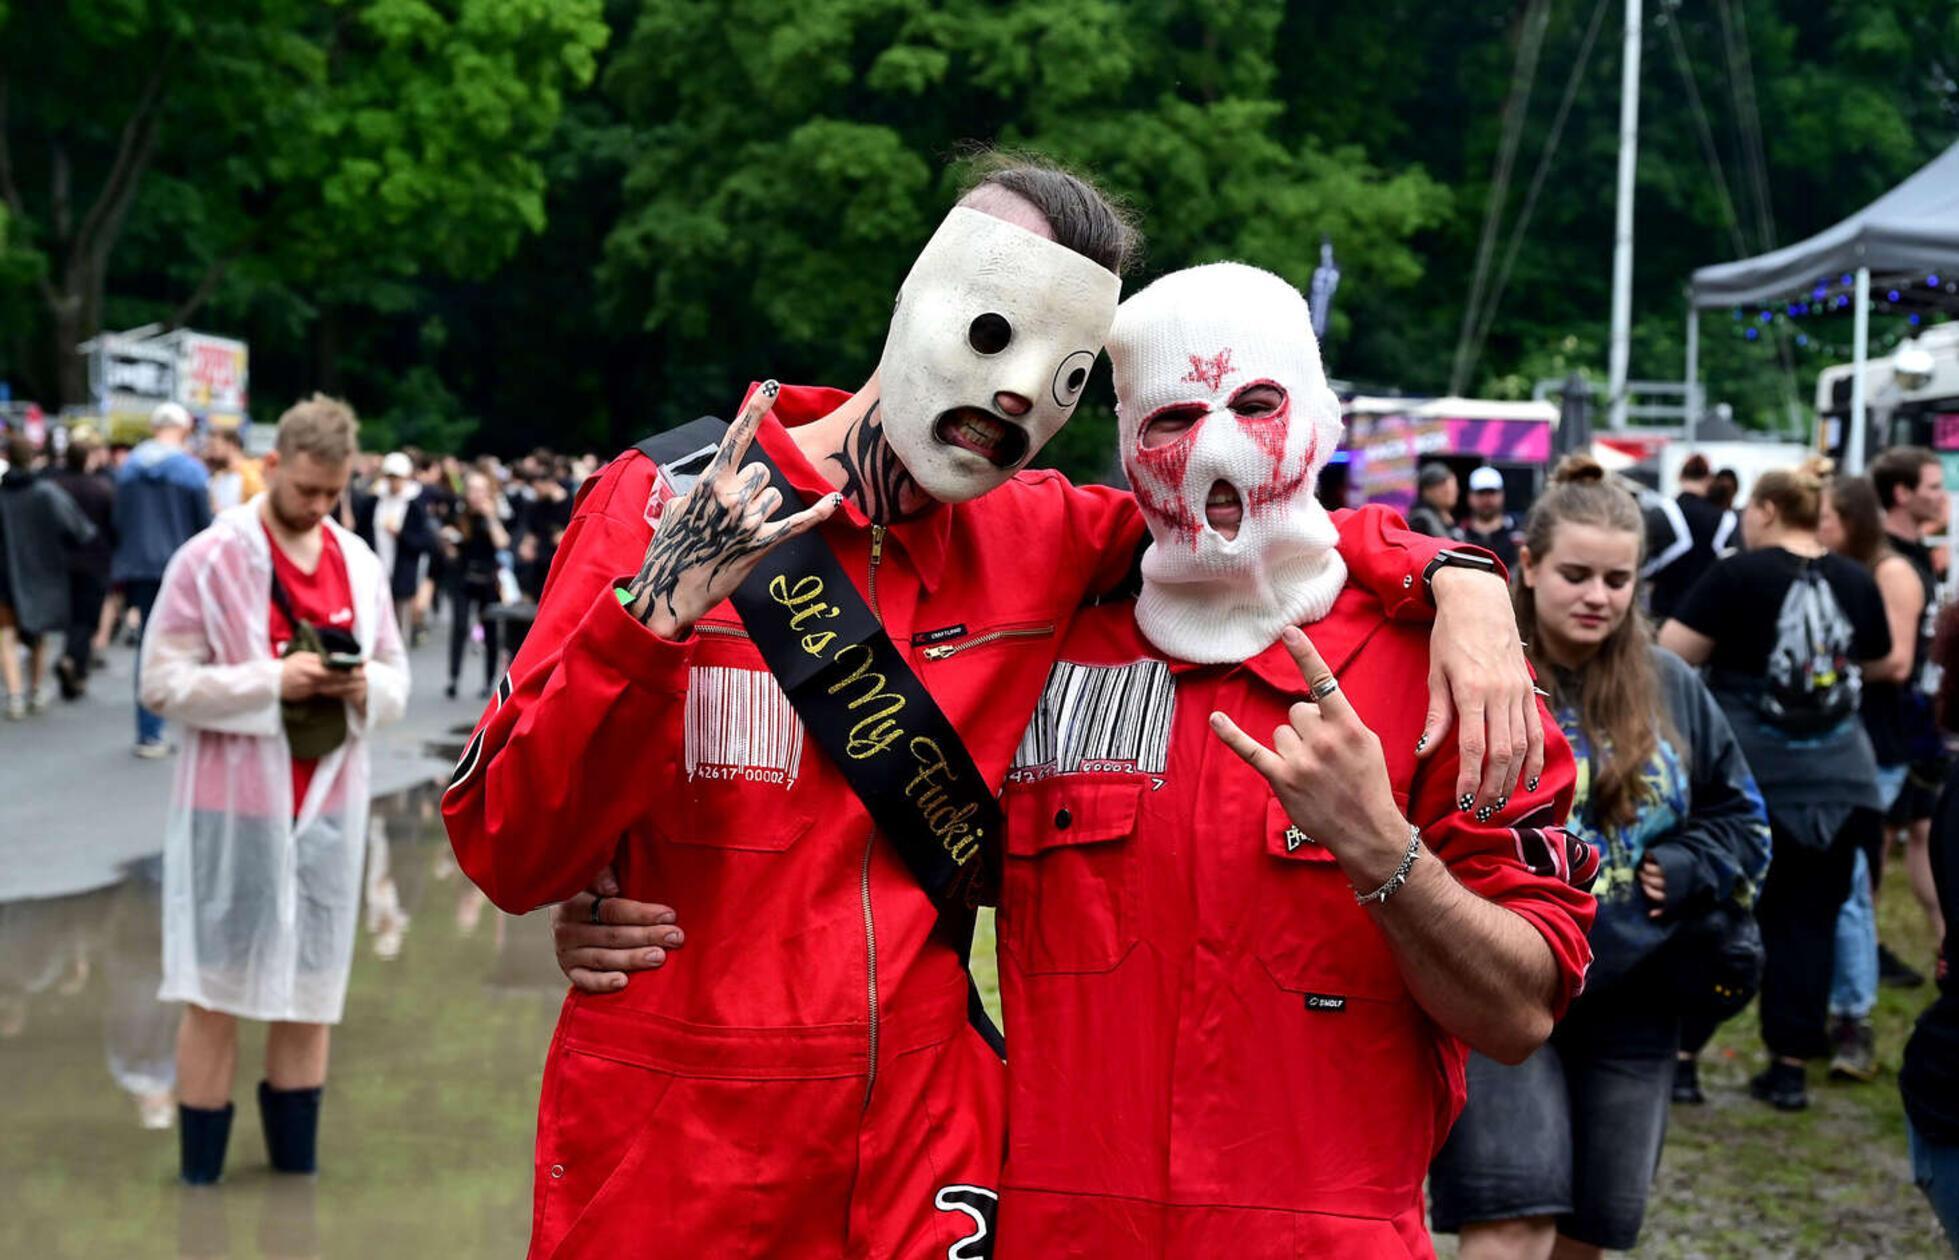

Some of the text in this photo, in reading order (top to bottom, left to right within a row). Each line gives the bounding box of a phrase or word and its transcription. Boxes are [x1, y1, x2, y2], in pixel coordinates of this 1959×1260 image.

[769, 574, 841, 658] It's
[827, 643, 906, 760] My
[698, 765, 738, 781] 42617
[745, 768, 784, 784] 00002
[1082, 763, 1134, 775] 00002
[1151, 777, 1164, 791] 7
